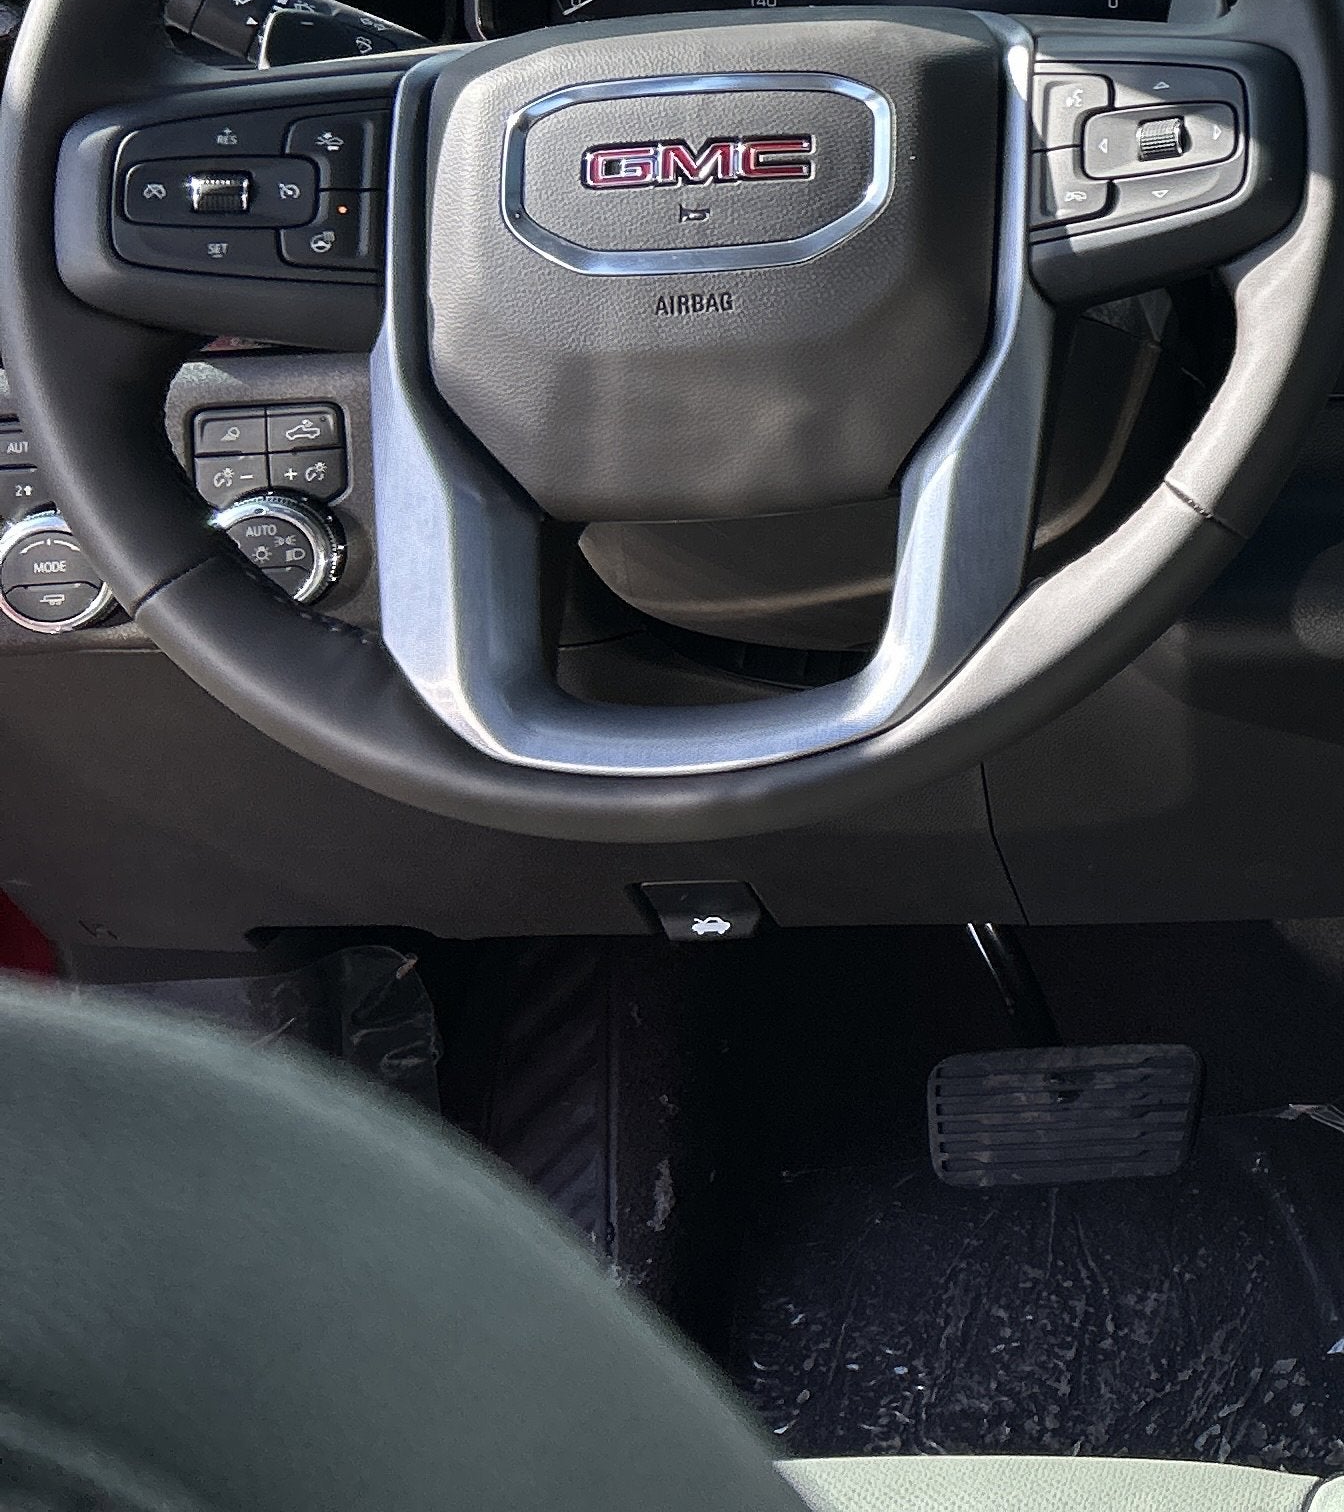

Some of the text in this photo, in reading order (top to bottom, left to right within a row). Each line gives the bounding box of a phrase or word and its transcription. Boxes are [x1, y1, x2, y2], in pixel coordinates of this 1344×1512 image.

[581, 134, 816, 190] GMC
[207, 242, 229, 255] SET
[655, 291, 734, 316] AIRBAG
[6, 441, 29, 454] AUT
[245, 524, 277, 537] AUTO
[33, 559, 67, 573] MODE
